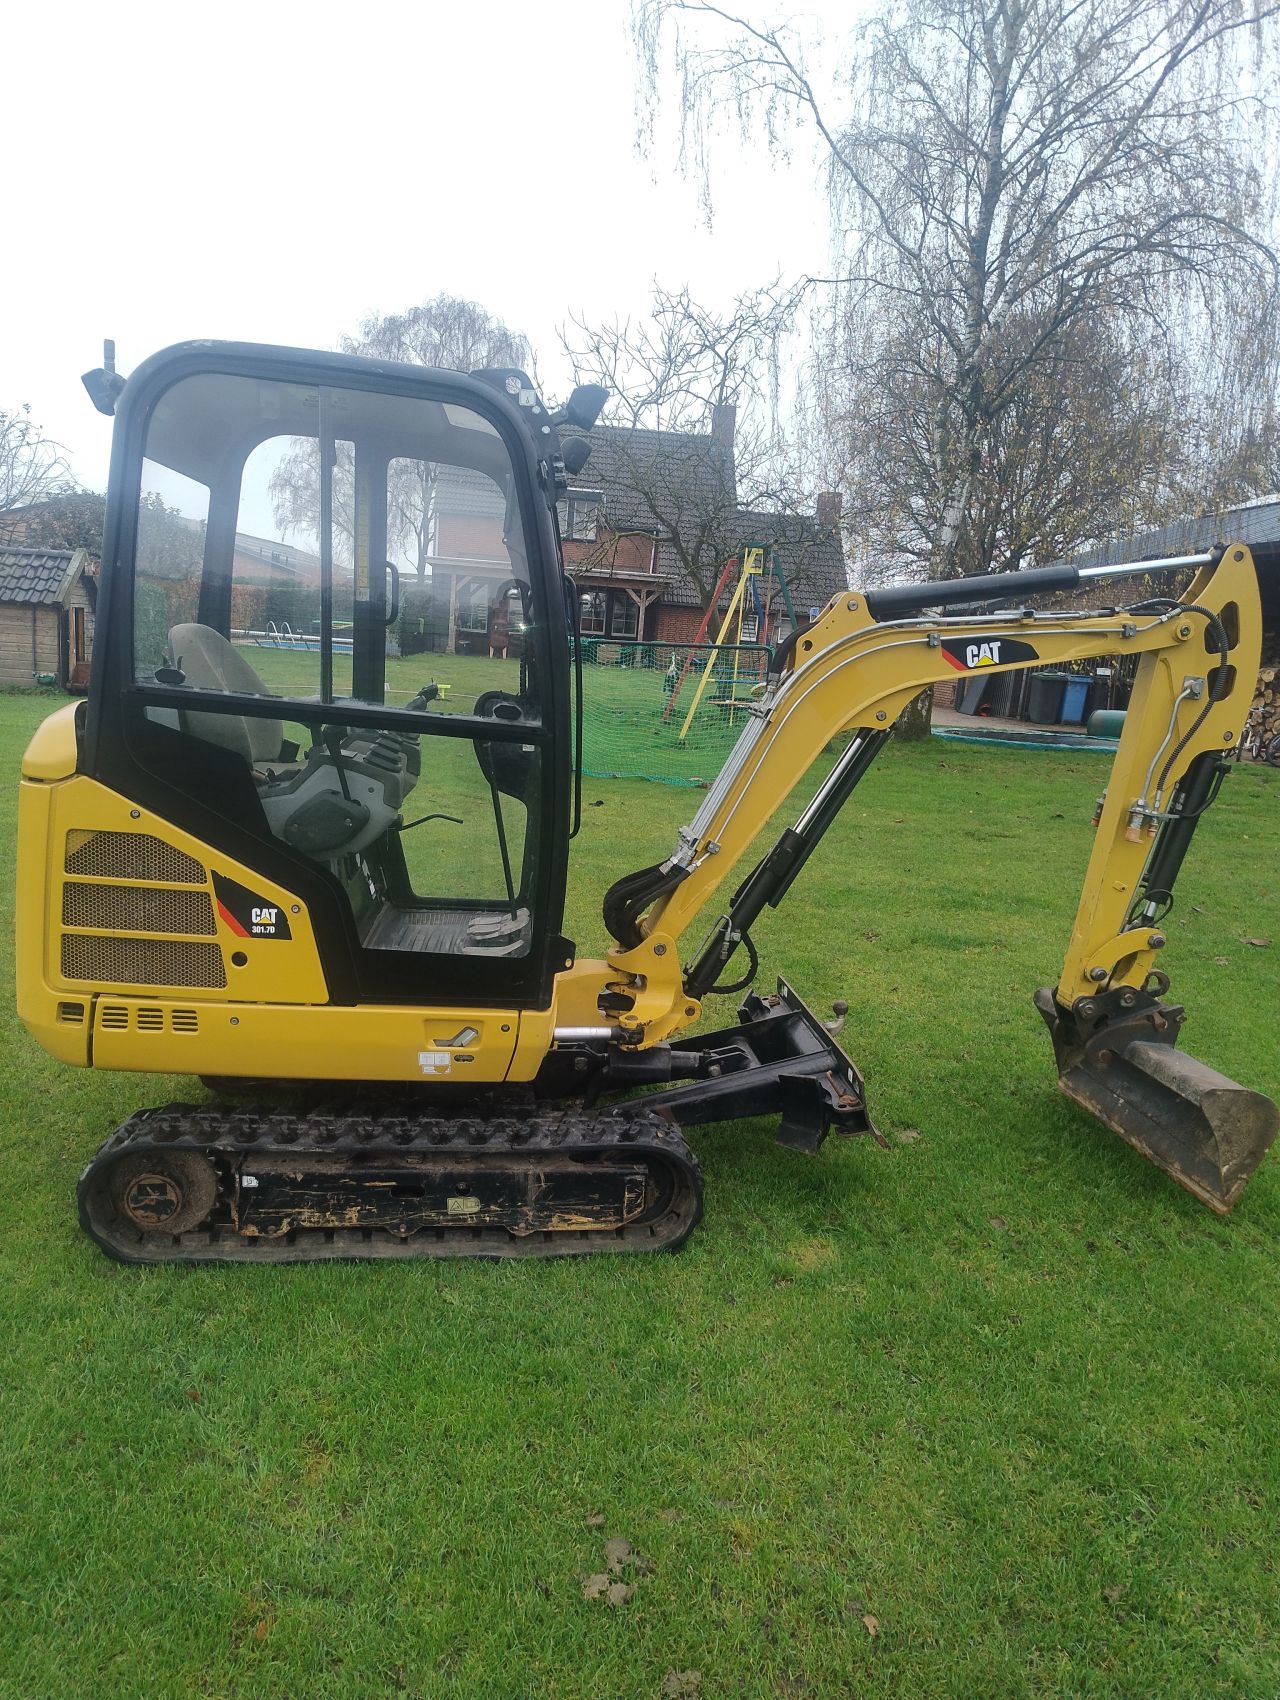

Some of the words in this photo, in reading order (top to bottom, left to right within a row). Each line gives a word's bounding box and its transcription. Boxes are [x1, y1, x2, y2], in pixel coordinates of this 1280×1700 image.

[966, 641, 1001, 668] CAT
[251, 907, 278, 924] CAT
[251, 925, 276, 934] 301.7D
